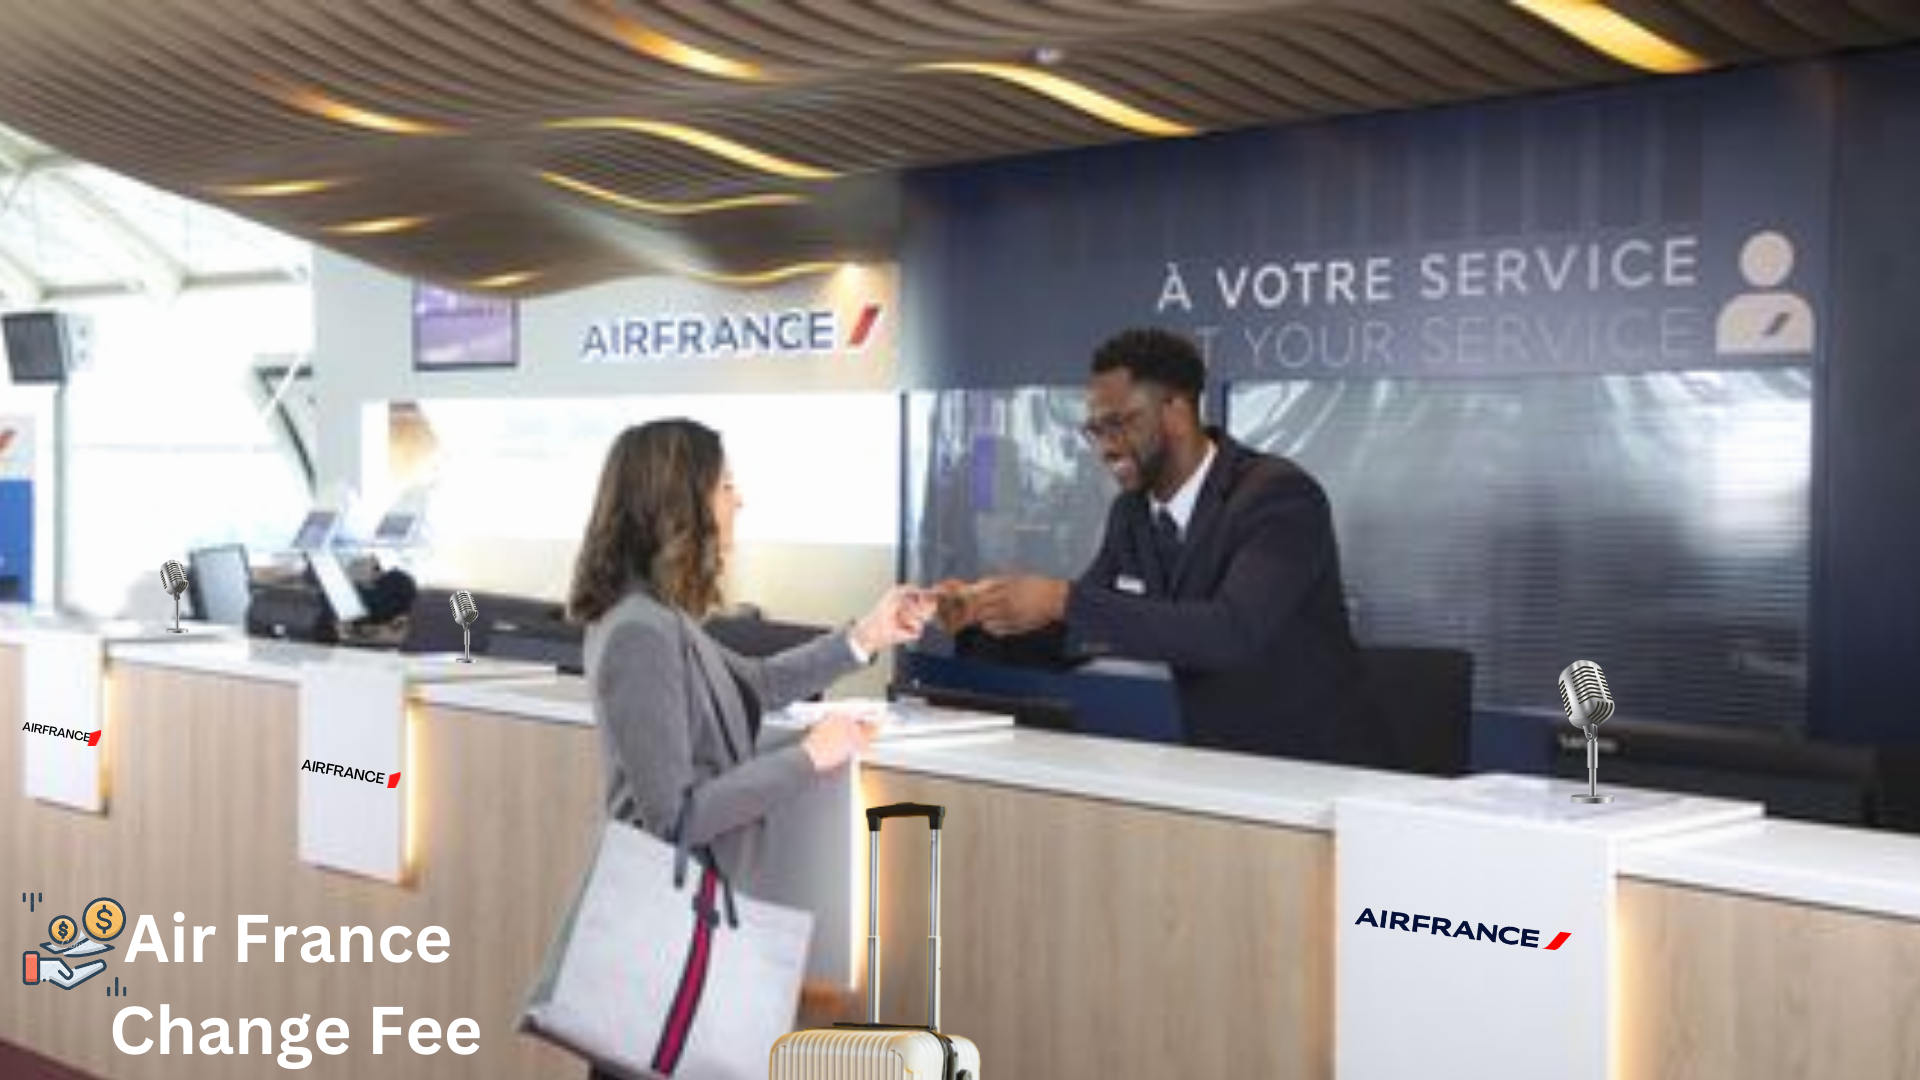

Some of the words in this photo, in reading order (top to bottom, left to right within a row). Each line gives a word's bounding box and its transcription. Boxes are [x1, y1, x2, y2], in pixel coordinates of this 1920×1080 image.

[1157, 262, 1193, 312] À
[1215, 258, 1393, 308] VOTRE
[1419, 236, 1698, 300] SERVICE
[582, 311, 834, 356] AIRFRANCE
[1242, 320, 1394, 370] YOUR
[1420, 305, 1694, 370] SERVICE
[21, 721, 91, 743] AIRFRANCE
[301, 758, 386, 785] AIRFRANCE
[1354, 907, 1540, 949] AIRFRANCE
